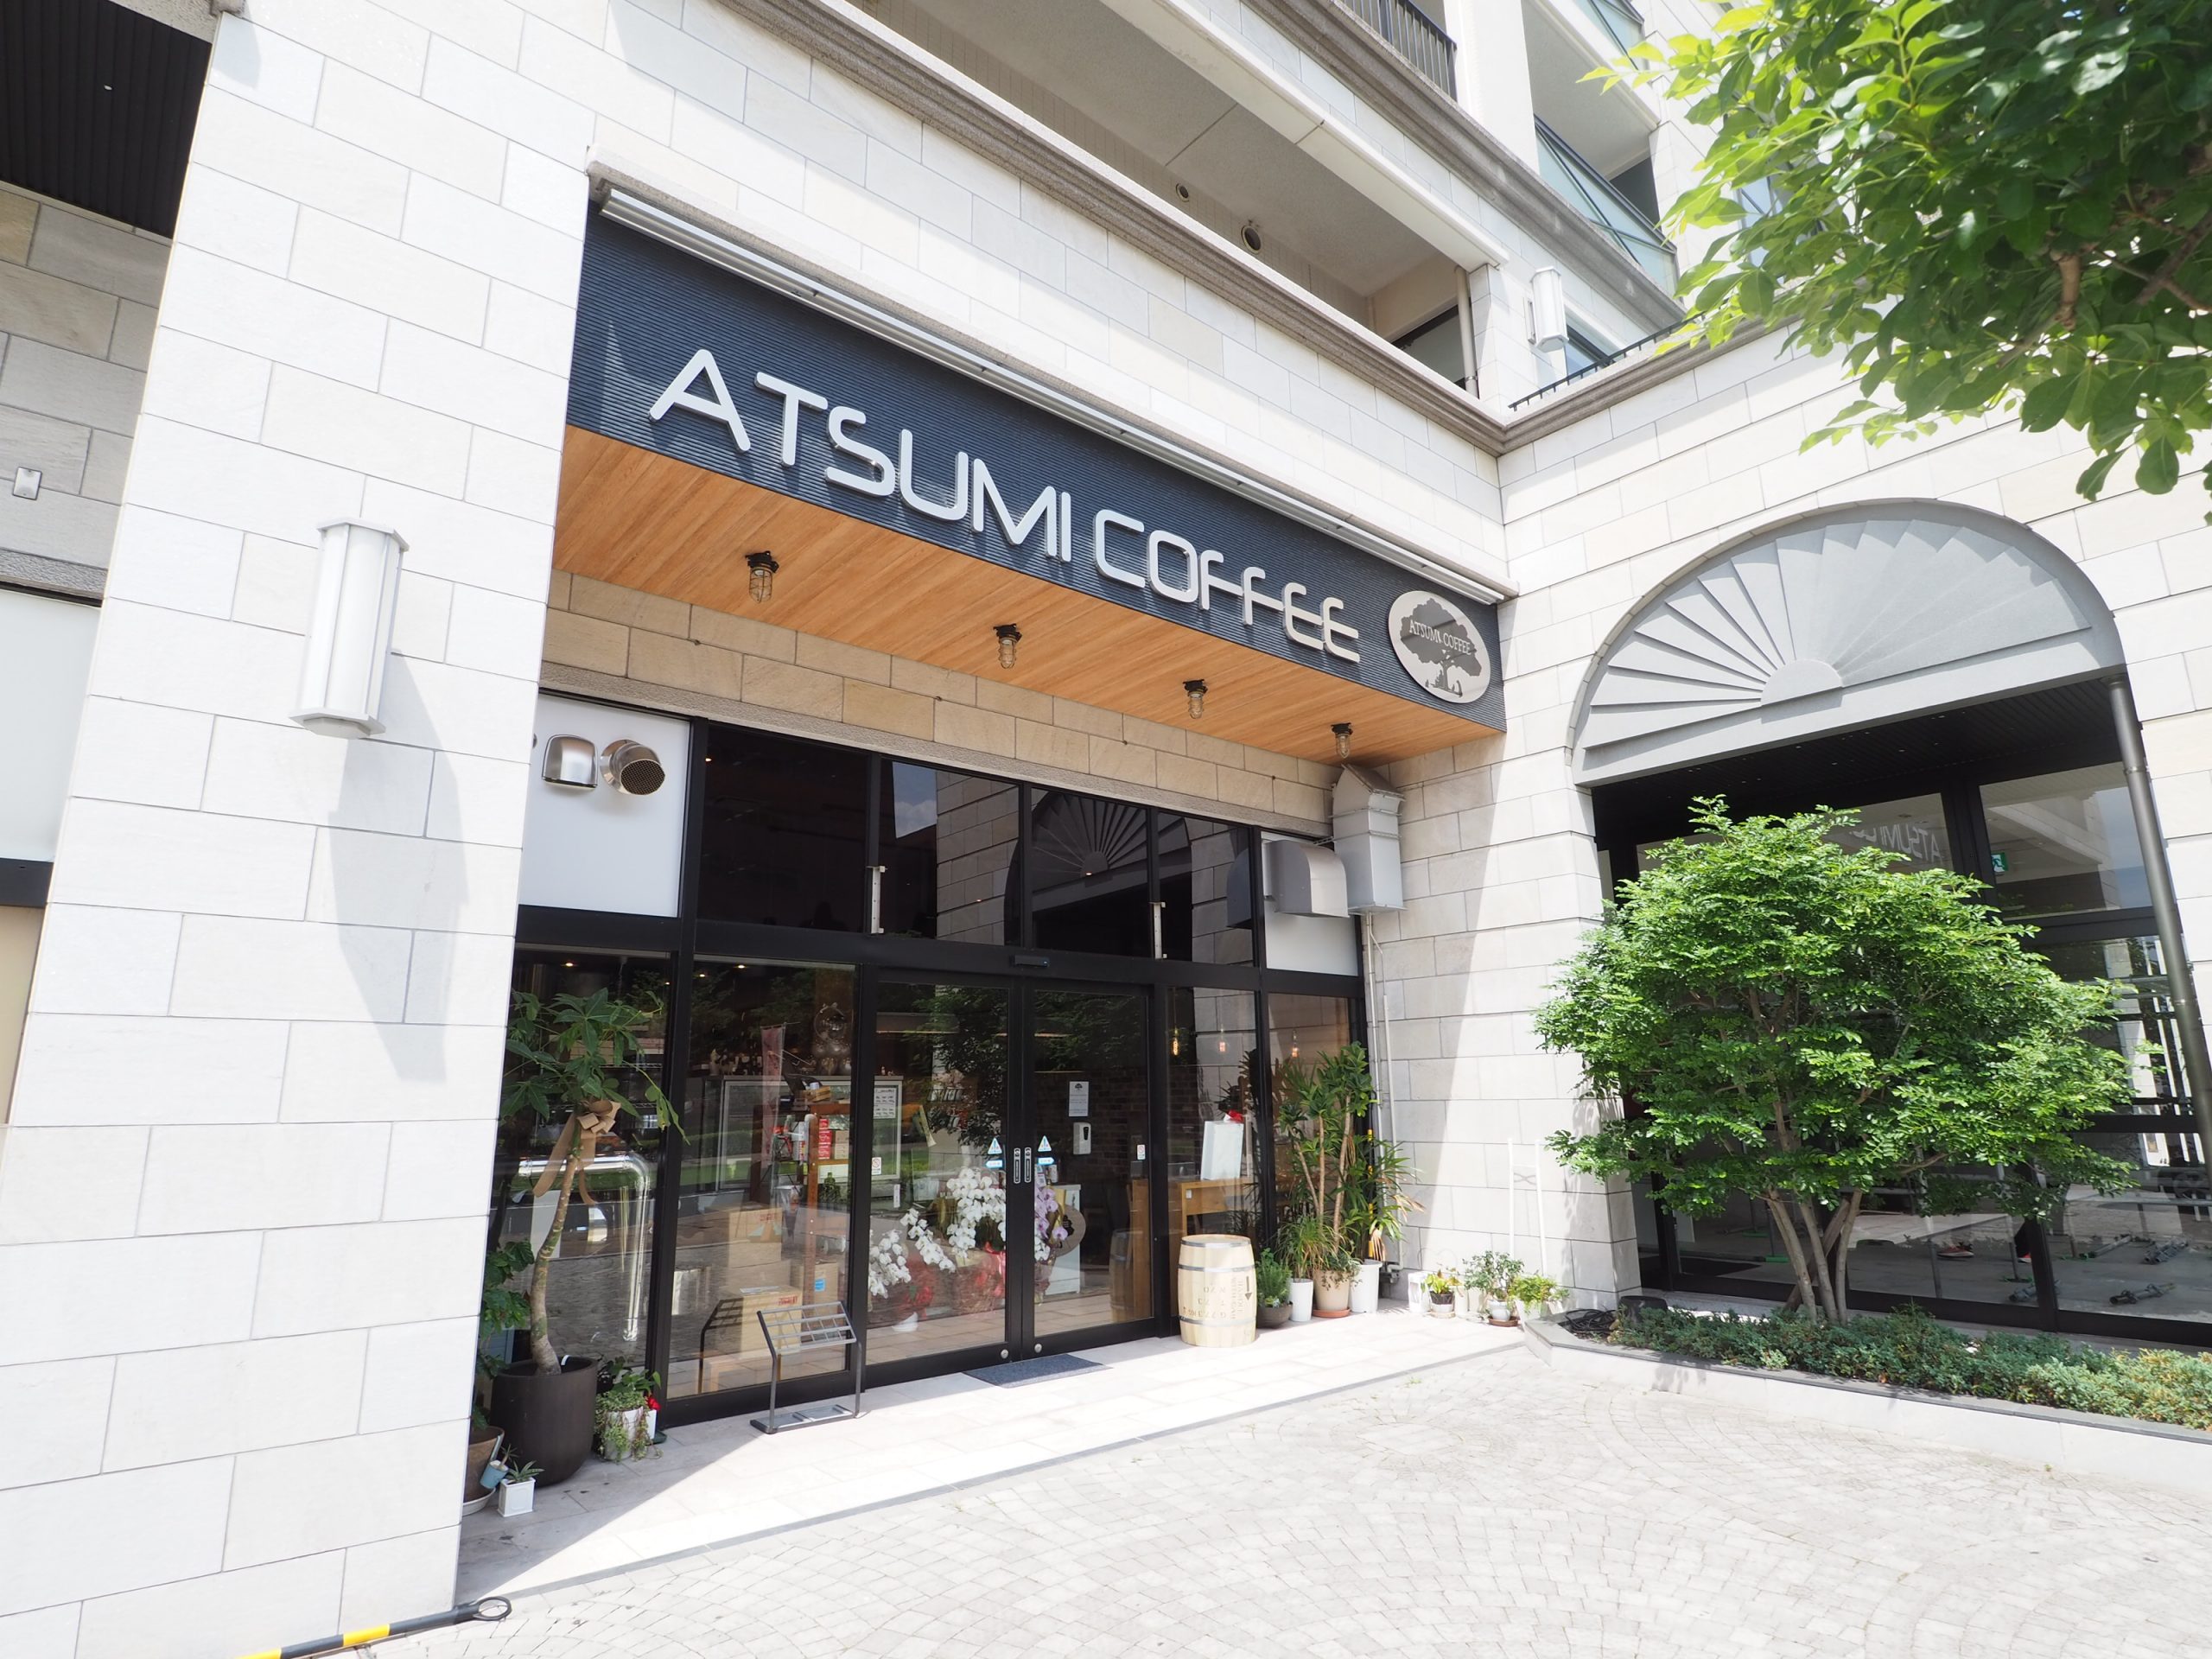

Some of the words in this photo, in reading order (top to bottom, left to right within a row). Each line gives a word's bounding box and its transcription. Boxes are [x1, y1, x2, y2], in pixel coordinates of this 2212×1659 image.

[648, 348, 1071, 563] ATSUMI
[1093, 509, 1361, 663] COFFEE
[1409, 620, 1441, 644] ATSUMI
[1442, 632, 1471, 655] COFFEE
